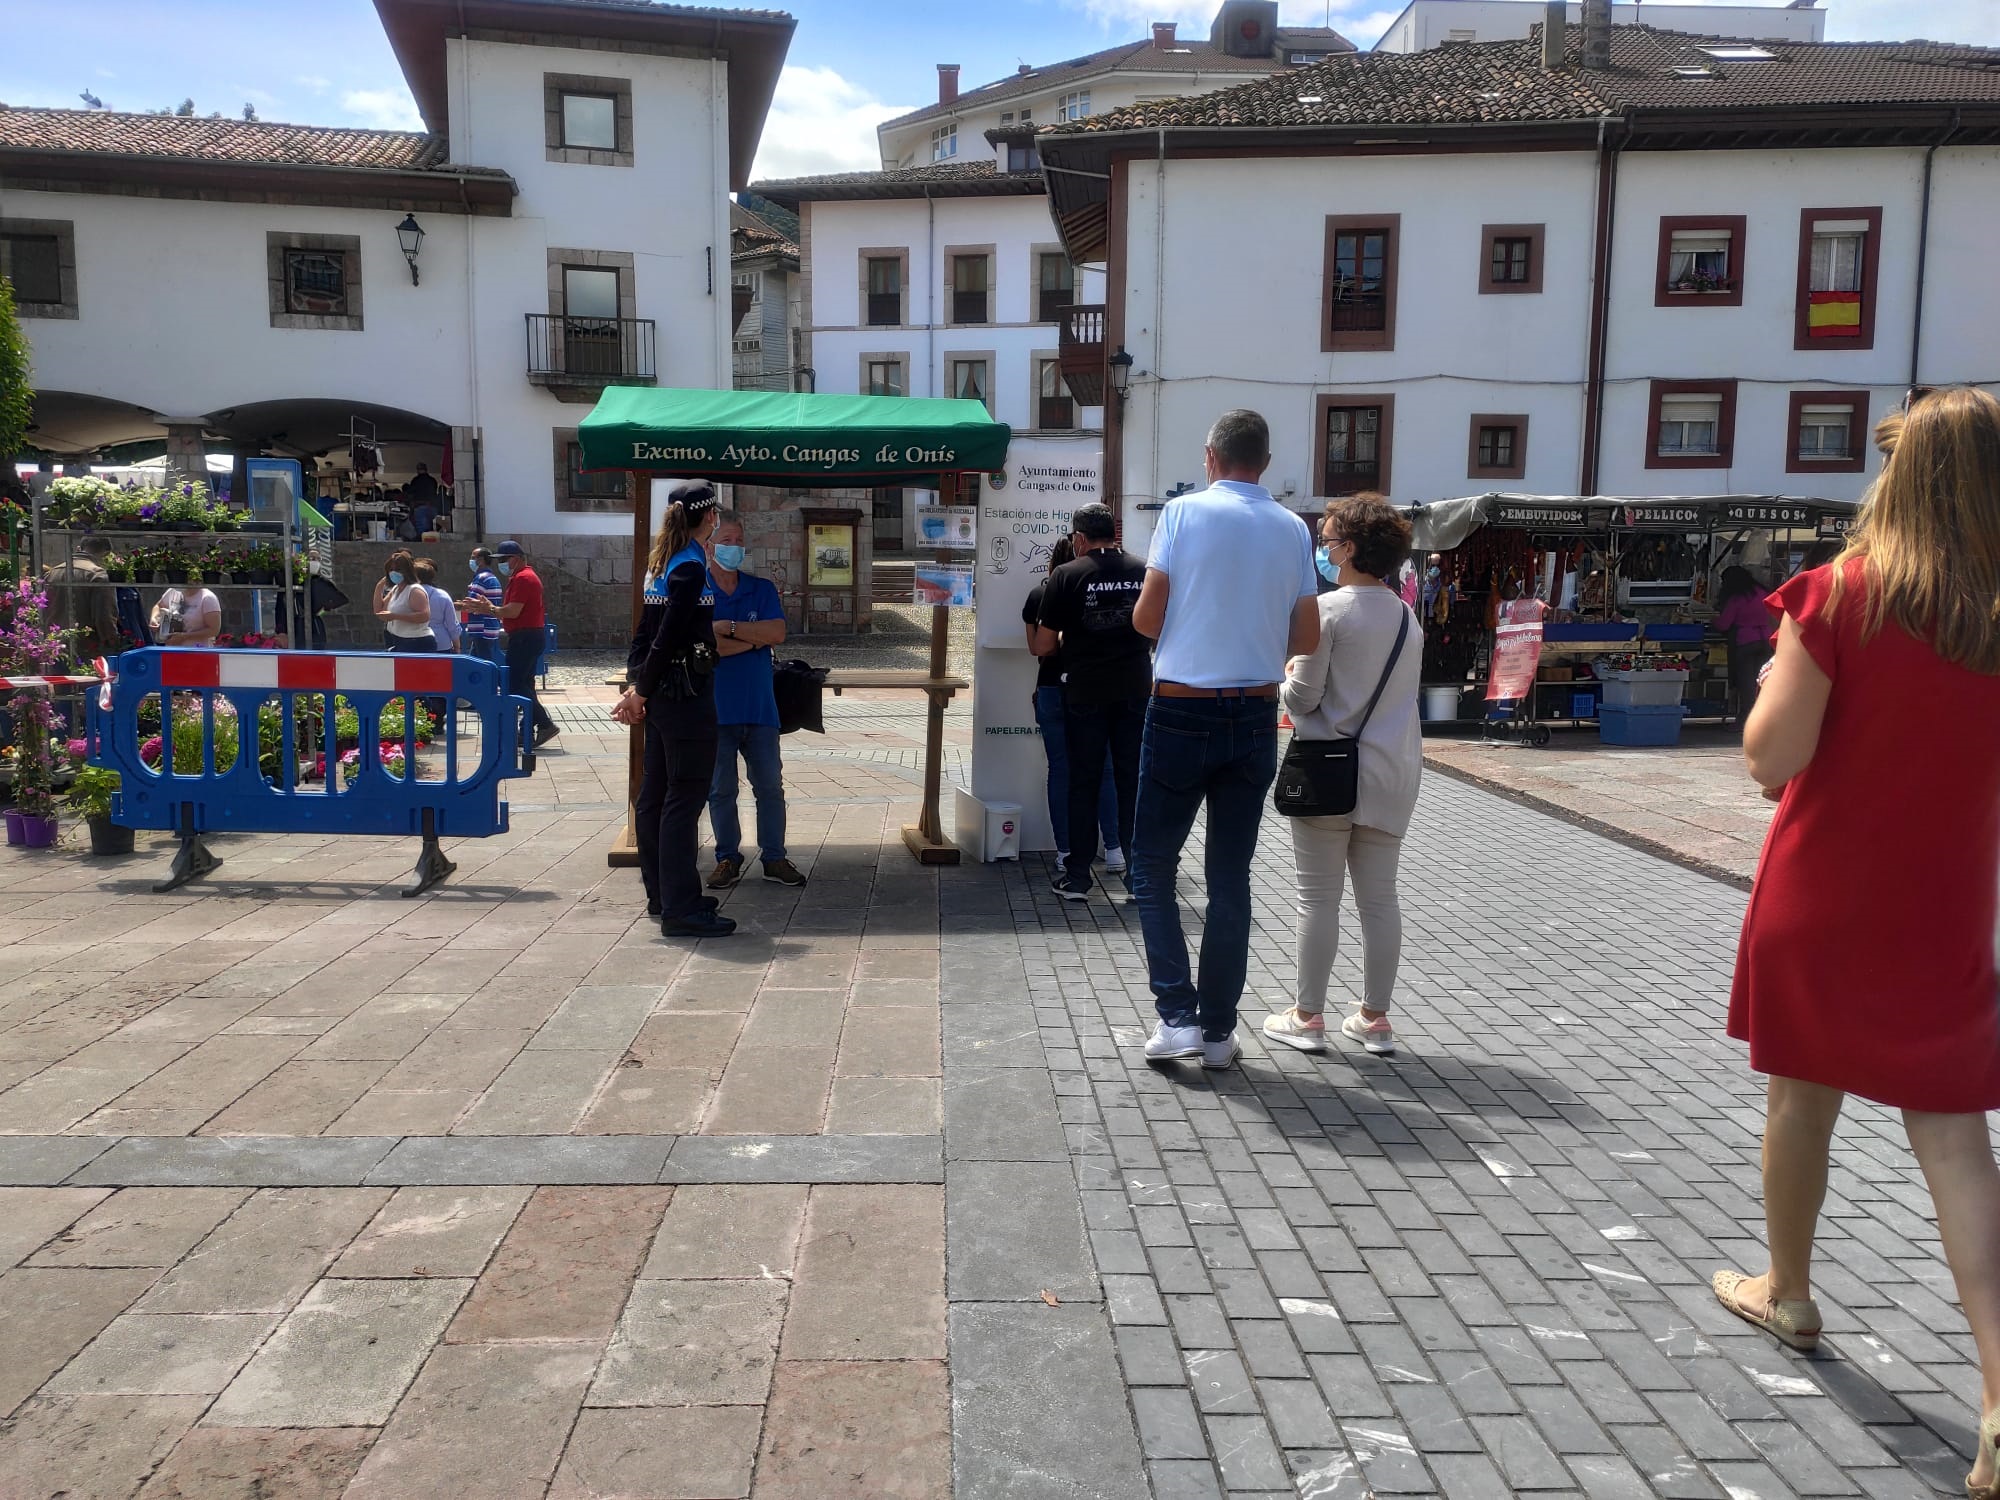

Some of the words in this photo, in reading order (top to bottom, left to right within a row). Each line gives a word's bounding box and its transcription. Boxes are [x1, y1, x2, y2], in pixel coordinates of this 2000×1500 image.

[631, 442, 713, 461] Excmo.
[720, 444, 777, 468] Ayto.
[782, 445, 860, 469] Cangas
[875, 444, 898, 463] de
[905, 444, 955, 463] Onís
[1019, 465, 1096, 479] Ayuntamiento
[1018, 480, 1055, 493] Cangas
[1057, 481, 1069, 491] de
[1072, 481, 1096, 492] Onís
[984, 507, 1032, 519] Estación
[1034, 509, 1049, 520] de
[1052, 510, 1073, 523] Higi
[1507, 508, 1577, 520] EMBUTIDOS
[1734, 507, 1800, 520] QUESOS
[1012, 523, 1068, 535] COVID-19
[1087, 581, 1144, 592] KAWASA
[985, 726, 1033, 735] PAPELERA
[1035, 726, 1041, 735] R
